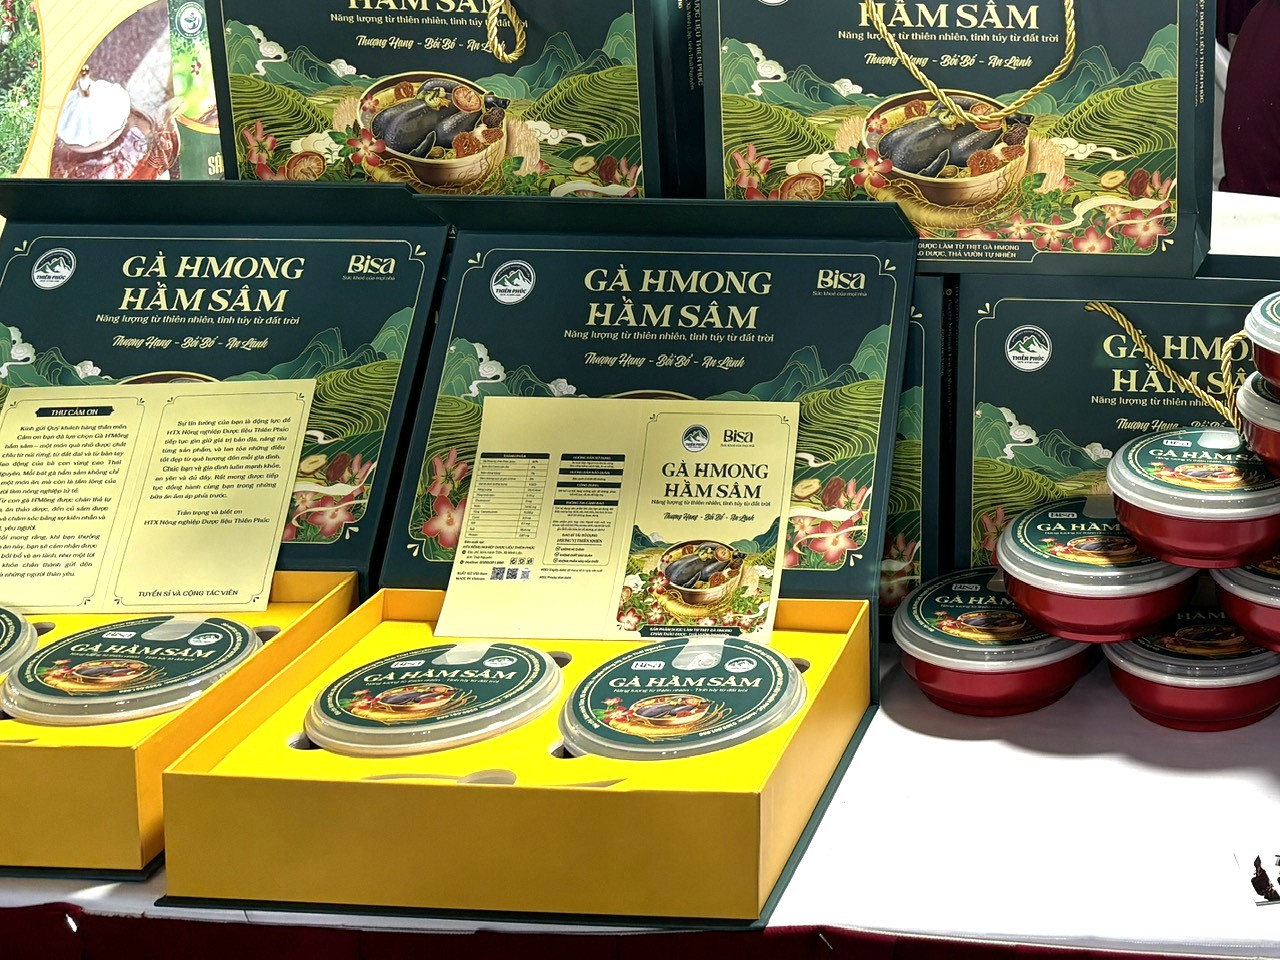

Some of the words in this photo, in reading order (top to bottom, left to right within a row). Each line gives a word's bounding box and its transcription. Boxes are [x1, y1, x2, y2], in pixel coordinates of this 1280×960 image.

[956, 0, 1040, 30] SÂM
[838, 30, 864, 41] Năng
[898, 32, 910, 41] từ
[911, 32, 937, 41] thiên
[938, 32, 969, 42] nhiên,
[970, 32, 990, 42] tinh
[991, 32, 1008, 44] túy
[1009, 33, 1022, 42] từ
[1022, 33, 1039, 43] đất
[1041, 34, 1059, 43] trời
[938, 241, 954, 250] LÀM
[955, 242, 965, 250] TỪ
[966, 243, 981, 251] THỊT
[982, 242, 993, 251] GÀ
[963, 250, 983, 258] VƯỜN
[984, 250, 995, 259] TỰ
[994, 250, 1016, 258] NHIÊN
[122, 250, 169, 279] GÀ
[174, 256, 306, 280] HMONG
[347, 254, 396, 275] Bisa
[584, 263, 633, 292] GÀ
[639, 269, 773, 295] HMONG
[816, 268, 867, 291] Bisa
[117, 281, 207, 312] HẦM
[207, 284, 290, 313] SÂM
[585, 295, 675, 328] HẦM
[677, 299, 760, 330] SÂM
[563, 329, 589, 340] Năng
[590, 330, 619, 341] lượng
[620, 330, 632, 340] từ
[633, 330, 658, 341] thiên
[659, 331, 688, 342] nhiên,
[689, 331, 708, 342] tinh
[709, 332, 725, 343] túy
[727, 332, 738, 342] từ
[738, 332, 756, 343] đất
[756, 333, 775, 343] trời
[1102, 328, 1147, 360] GÀ
[584, 351, 618, 367] Thượng
[618, 353, 647, 368] Hạng
[656, 352, 676, 368] Bồi
[675, 353, 694, 368] Bổ
[701, 355, 717, 368] An
[716, 355, 746, 371] Lành
[1012, 354, 1029, 362] THIÊN
[1029, 354, 1046, 362] PHÚC
[1112, 365, 1200, 394] HẦM
[51, 408, 69, 416] THƯ
[69, 408, 86, 416] CẢM
[86, 408, 99, 416] ƠN
[723, 428, 754, 444] Bisa
[1148, 447, 1180, 459] GÀ
[1182, 447, 1233, 461] HẦM
[661, 459, 690, 479] GÀ
[694, 462, 769, 480] HMONG
[663, 479, 713, 498] HẦM
[715, 480, 763, 499] SÂM
[1036, 518, 1078, 532] GÀ
[172, 589, 182, 597] VÀ
[182, 589, 204, 598] CỘNG
[205, 588, 220, 596] TÁC
[220, 588, 239, 596] VIÊN
[363, 671, 396, 683] GÀ
[400, 668, 460, 681] HẦM
[460, 668, 518, 681] SÂM
[609, 675, 642, 688] GÀ
[645, 674, 707, 688] HẦM
[707, 675, 763, 688] SÂM
